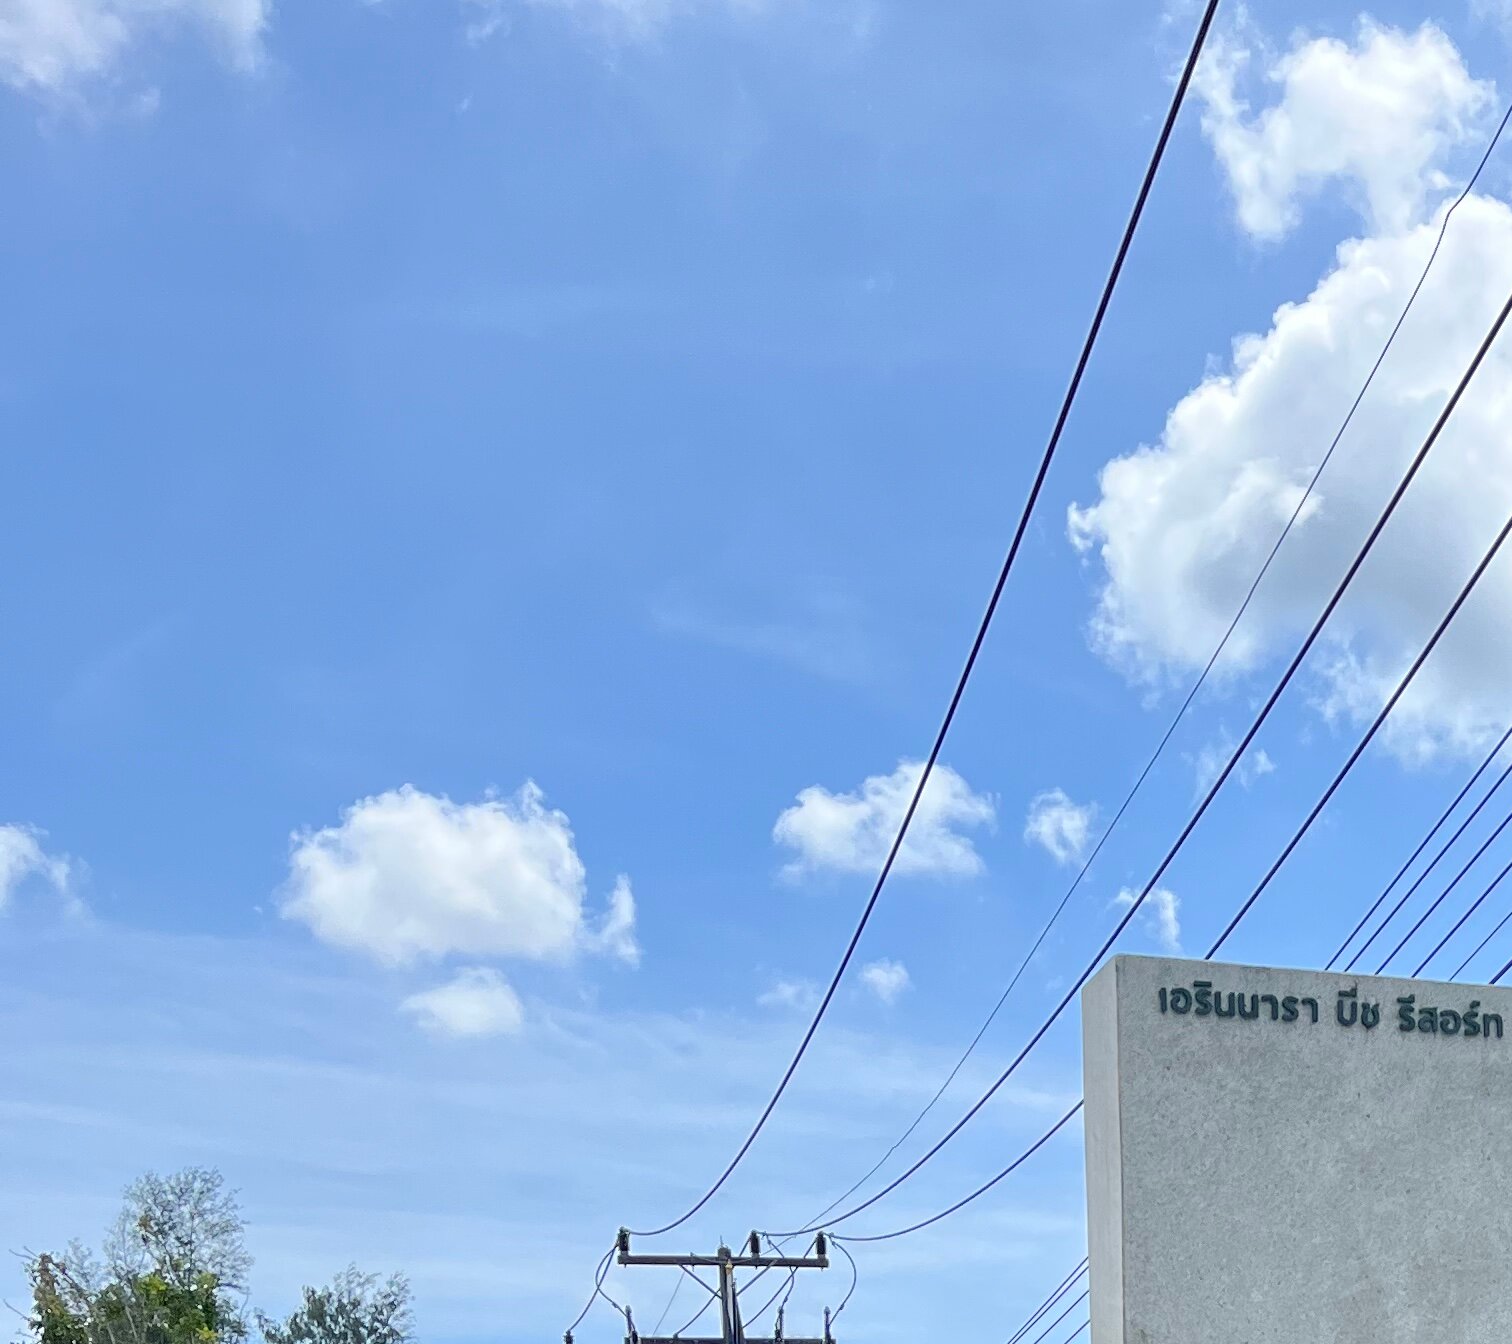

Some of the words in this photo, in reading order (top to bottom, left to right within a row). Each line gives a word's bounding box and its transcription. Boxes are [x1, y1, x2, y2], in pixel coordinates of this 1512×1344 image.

[1158, 980, 1319, 1023] เอรินนารา
[1396, 993, 1504, 1038] รีสอร์ท
